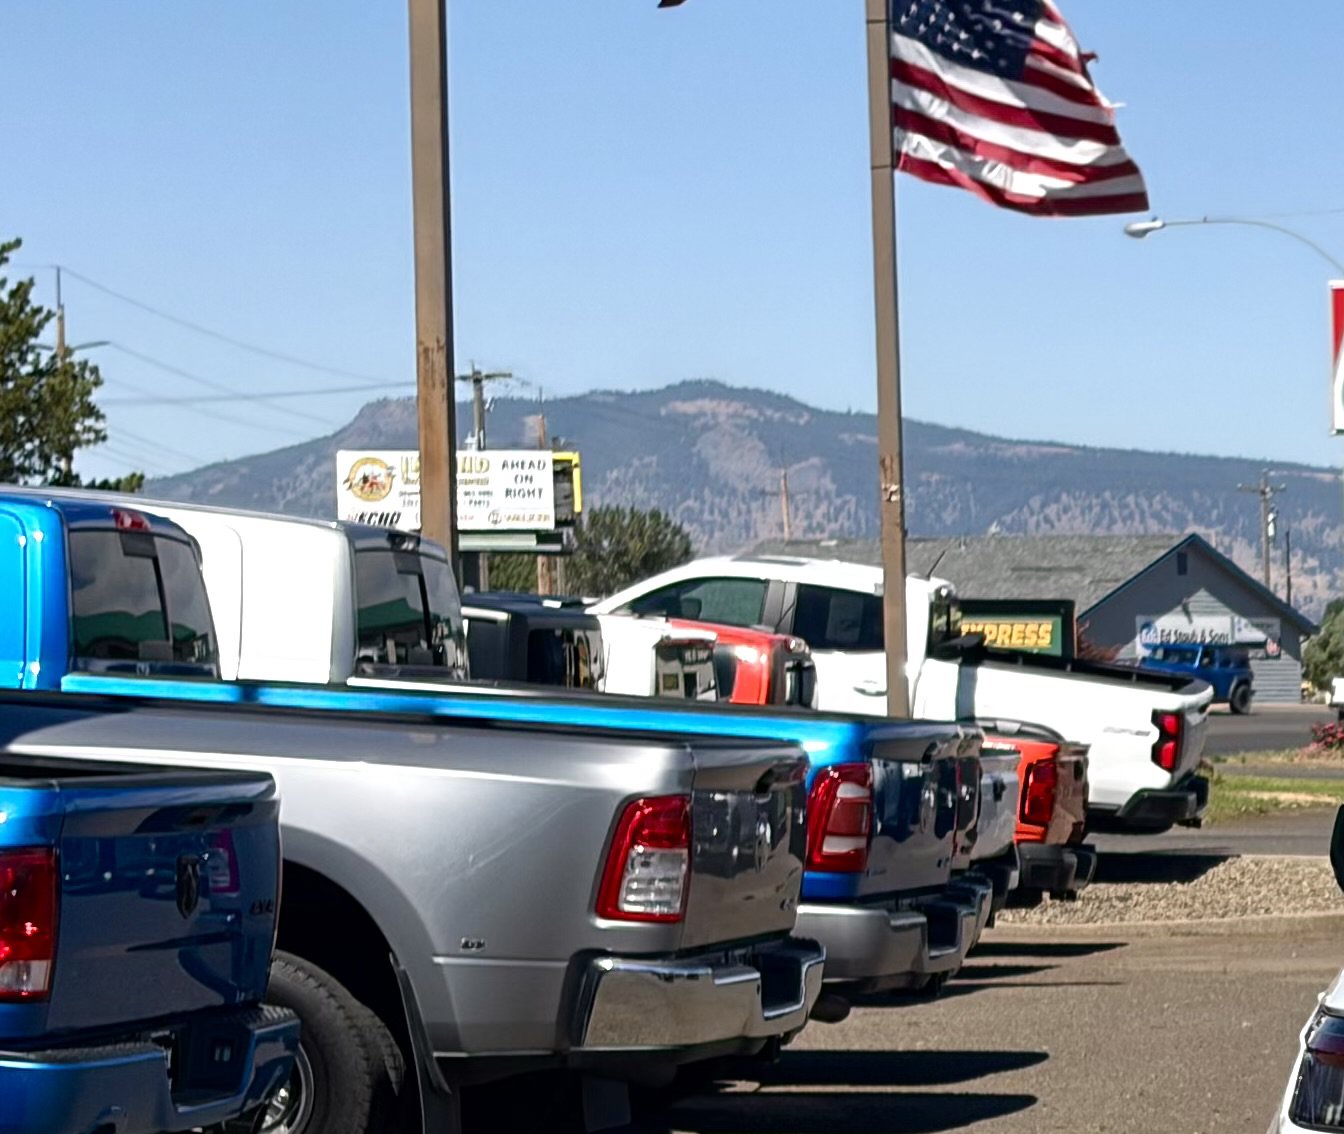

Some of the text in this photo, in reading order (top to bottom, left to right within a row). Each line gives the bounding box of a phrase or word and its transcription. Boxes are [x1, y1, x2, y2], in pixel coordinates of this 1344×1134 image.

[501, 459, 546, 471] AHEAD
[514, 474, 534, 484] ON
[505, 487, 543, 499] RIGHT
